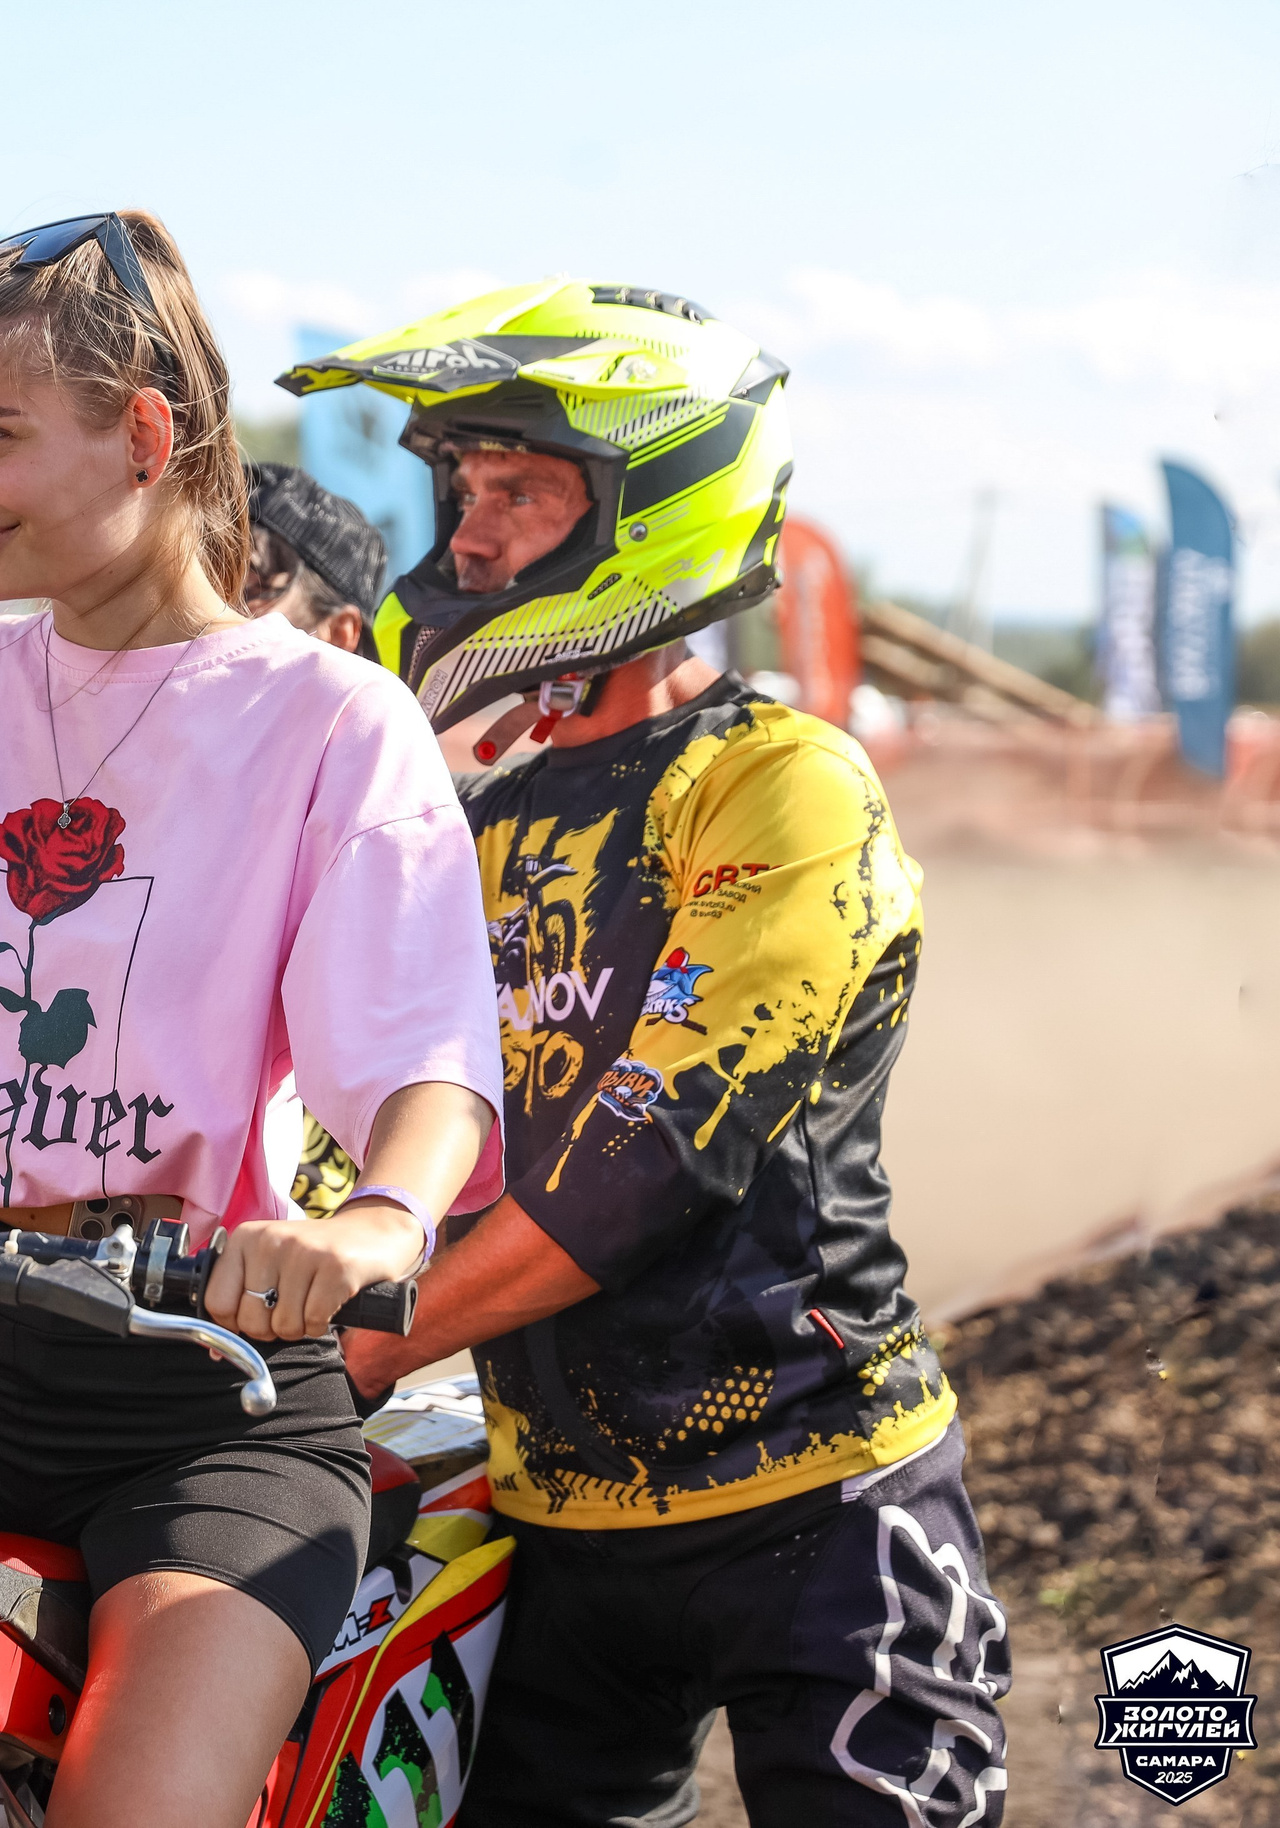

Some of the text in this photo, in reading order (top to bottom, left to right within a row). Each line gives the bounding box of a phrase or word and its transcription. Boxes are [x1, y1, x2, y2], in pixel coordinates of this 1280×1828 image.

[717, 888, 747, 904] ЗАВОД
[497, 967, 614, 1031] ANOV
[328, 1593, 396, 1655] M-Z
